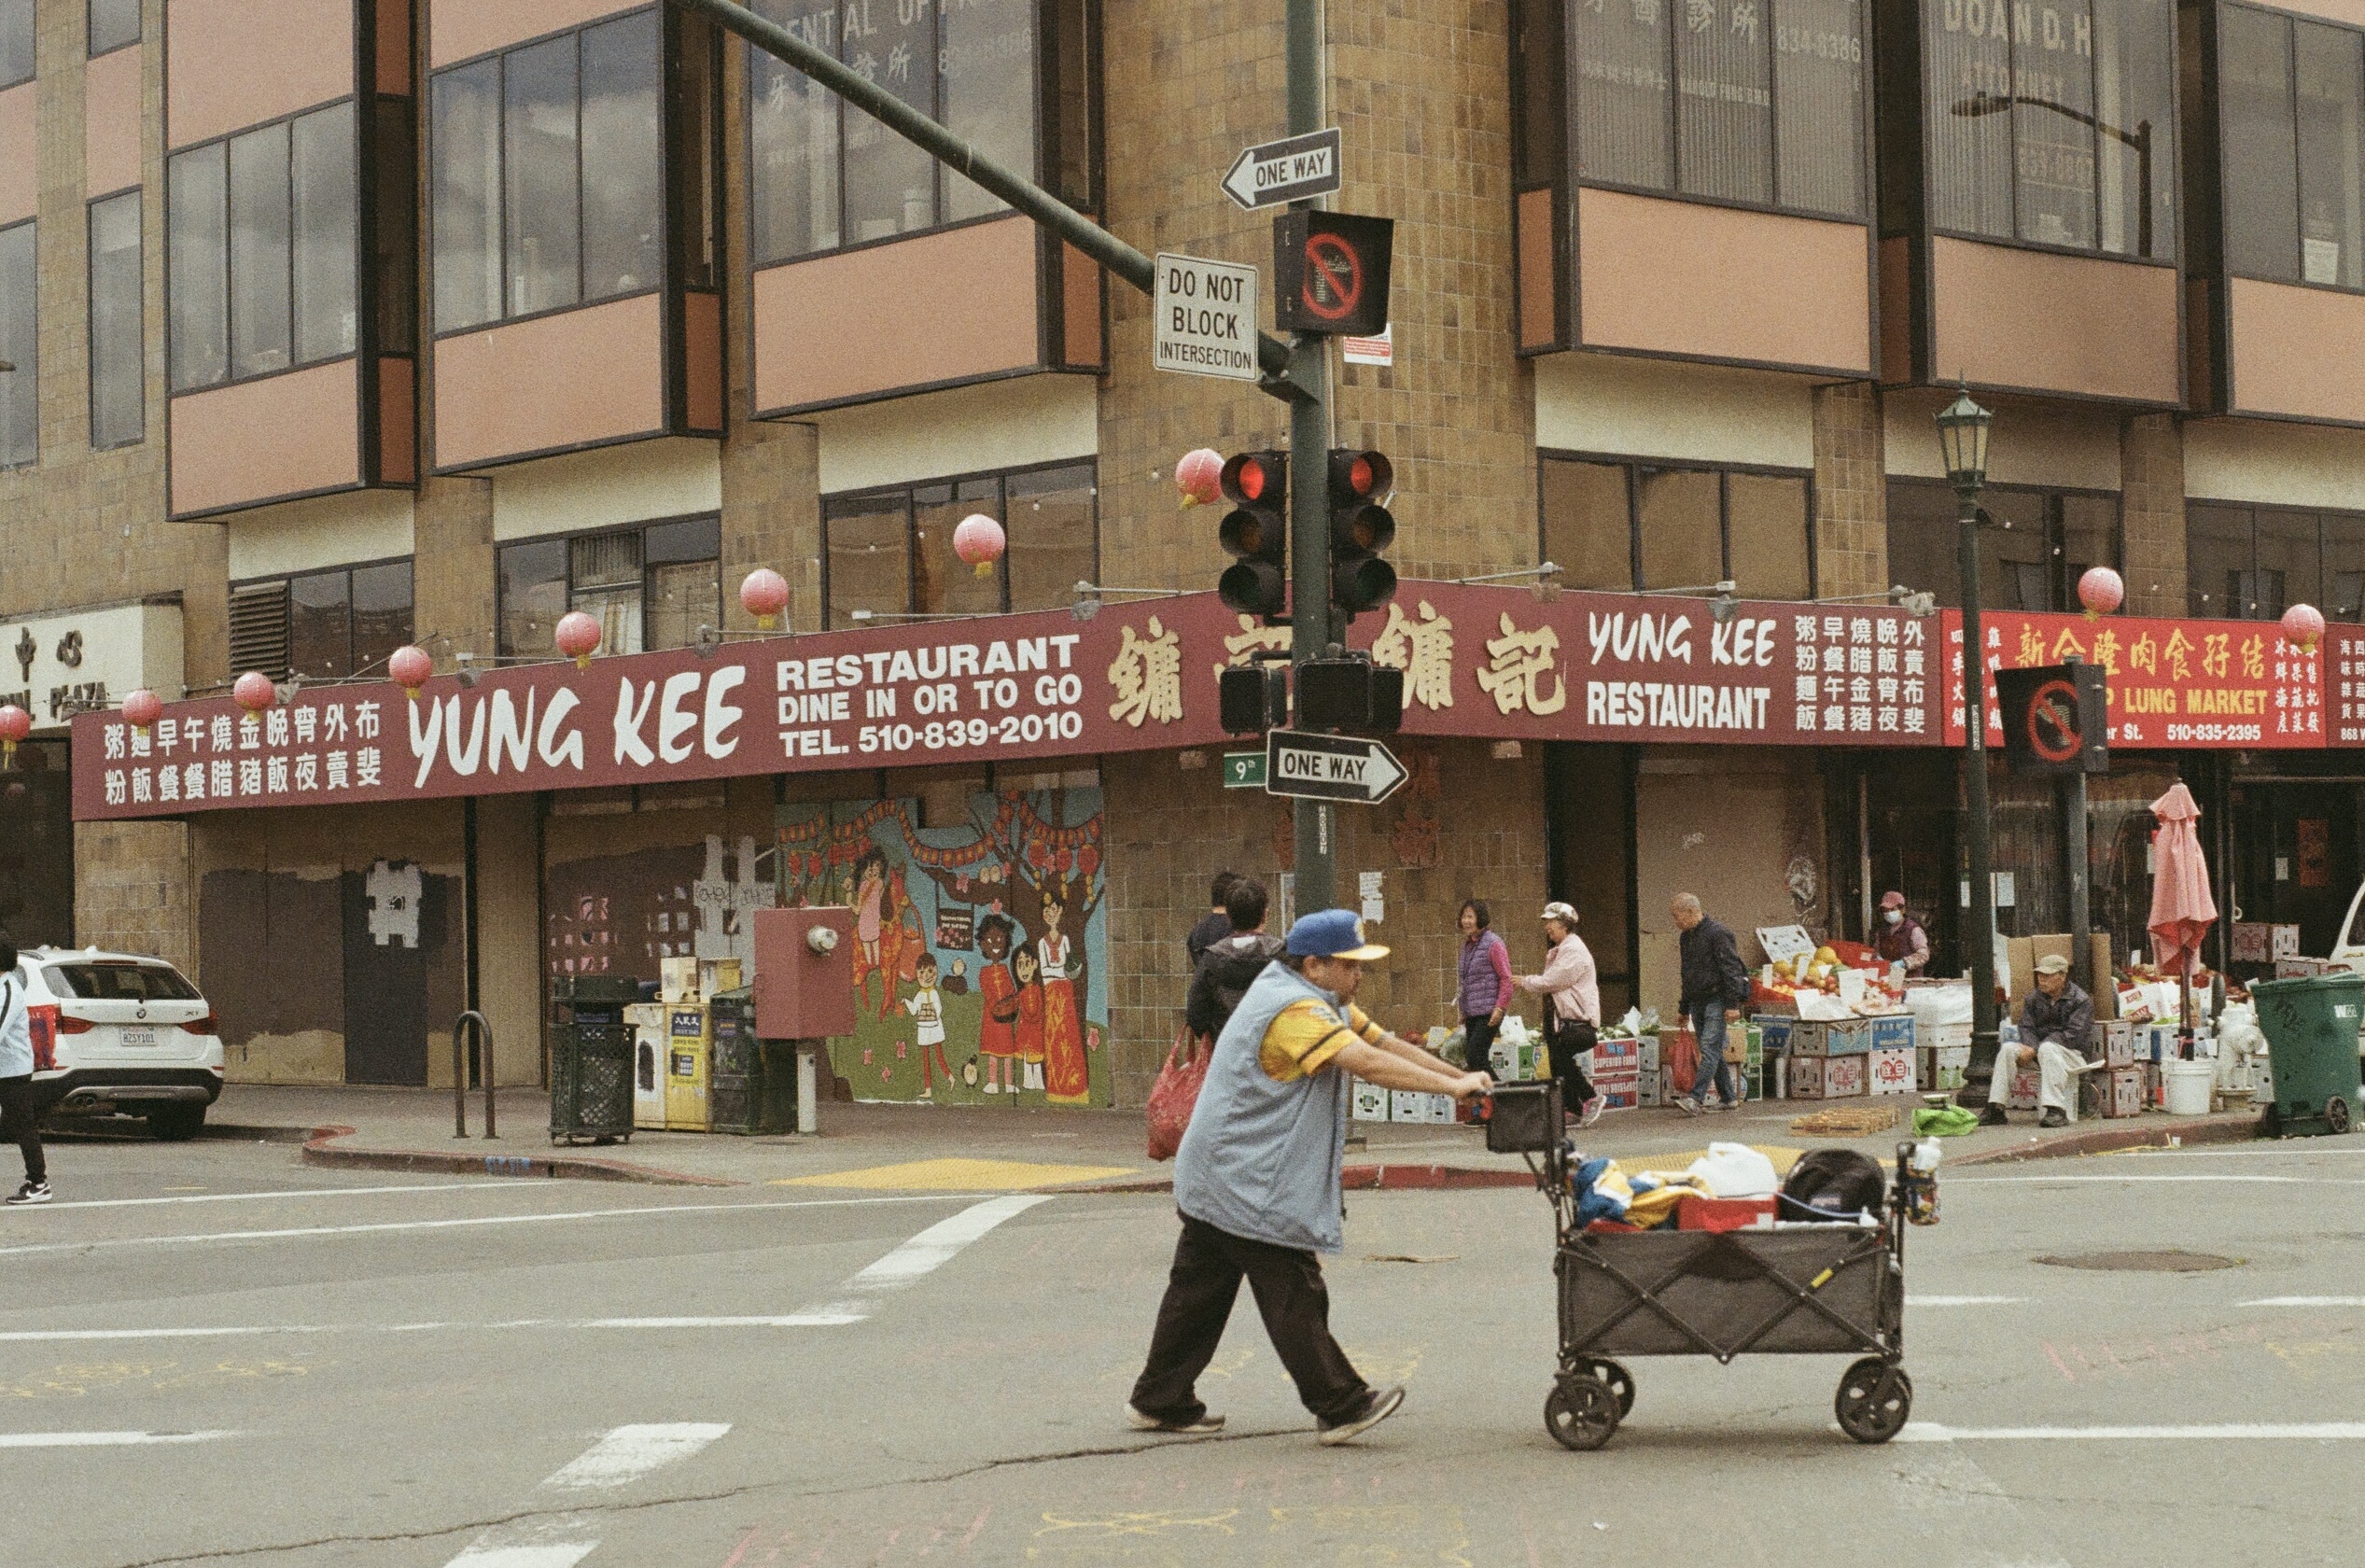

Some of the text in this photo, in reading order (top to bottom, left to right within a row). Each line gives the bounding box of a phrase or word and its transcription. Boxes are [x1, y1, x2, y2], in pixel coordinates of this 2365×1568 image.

[1255, 151, 1327, 188] ONE WAY
[1169, 268, 1244, 303] DO NOT
[1172, 306, 1238, 340] BLOCK
[1160, 341, 1252, 370] INTERSECTION
[1588, 611, 1777, 666] YUNG KEE
[777, 635, 1080, 692] RESTAURANT
[778, 673, 1083, 724] DINE IN OR TO GO
[1588, 681, 1771, 729] RESTAURANT
[2124, 687, 2176, 714] LUNG
[2187, 689, 2268, 715] MARKET
[408, 665, 746, 789] YUNG KEE
[779, 711, 1083, 757] TEL. 510-839-2010
[2123, 722, 2144, 740] St.
[2167, 723, 2261, 741] 510-835-2395
[2341, 728, 2358, 740] 868
[1235, 759, 1256, 780] 9th
[1284, 752, 1366, 780] ONE WAY
